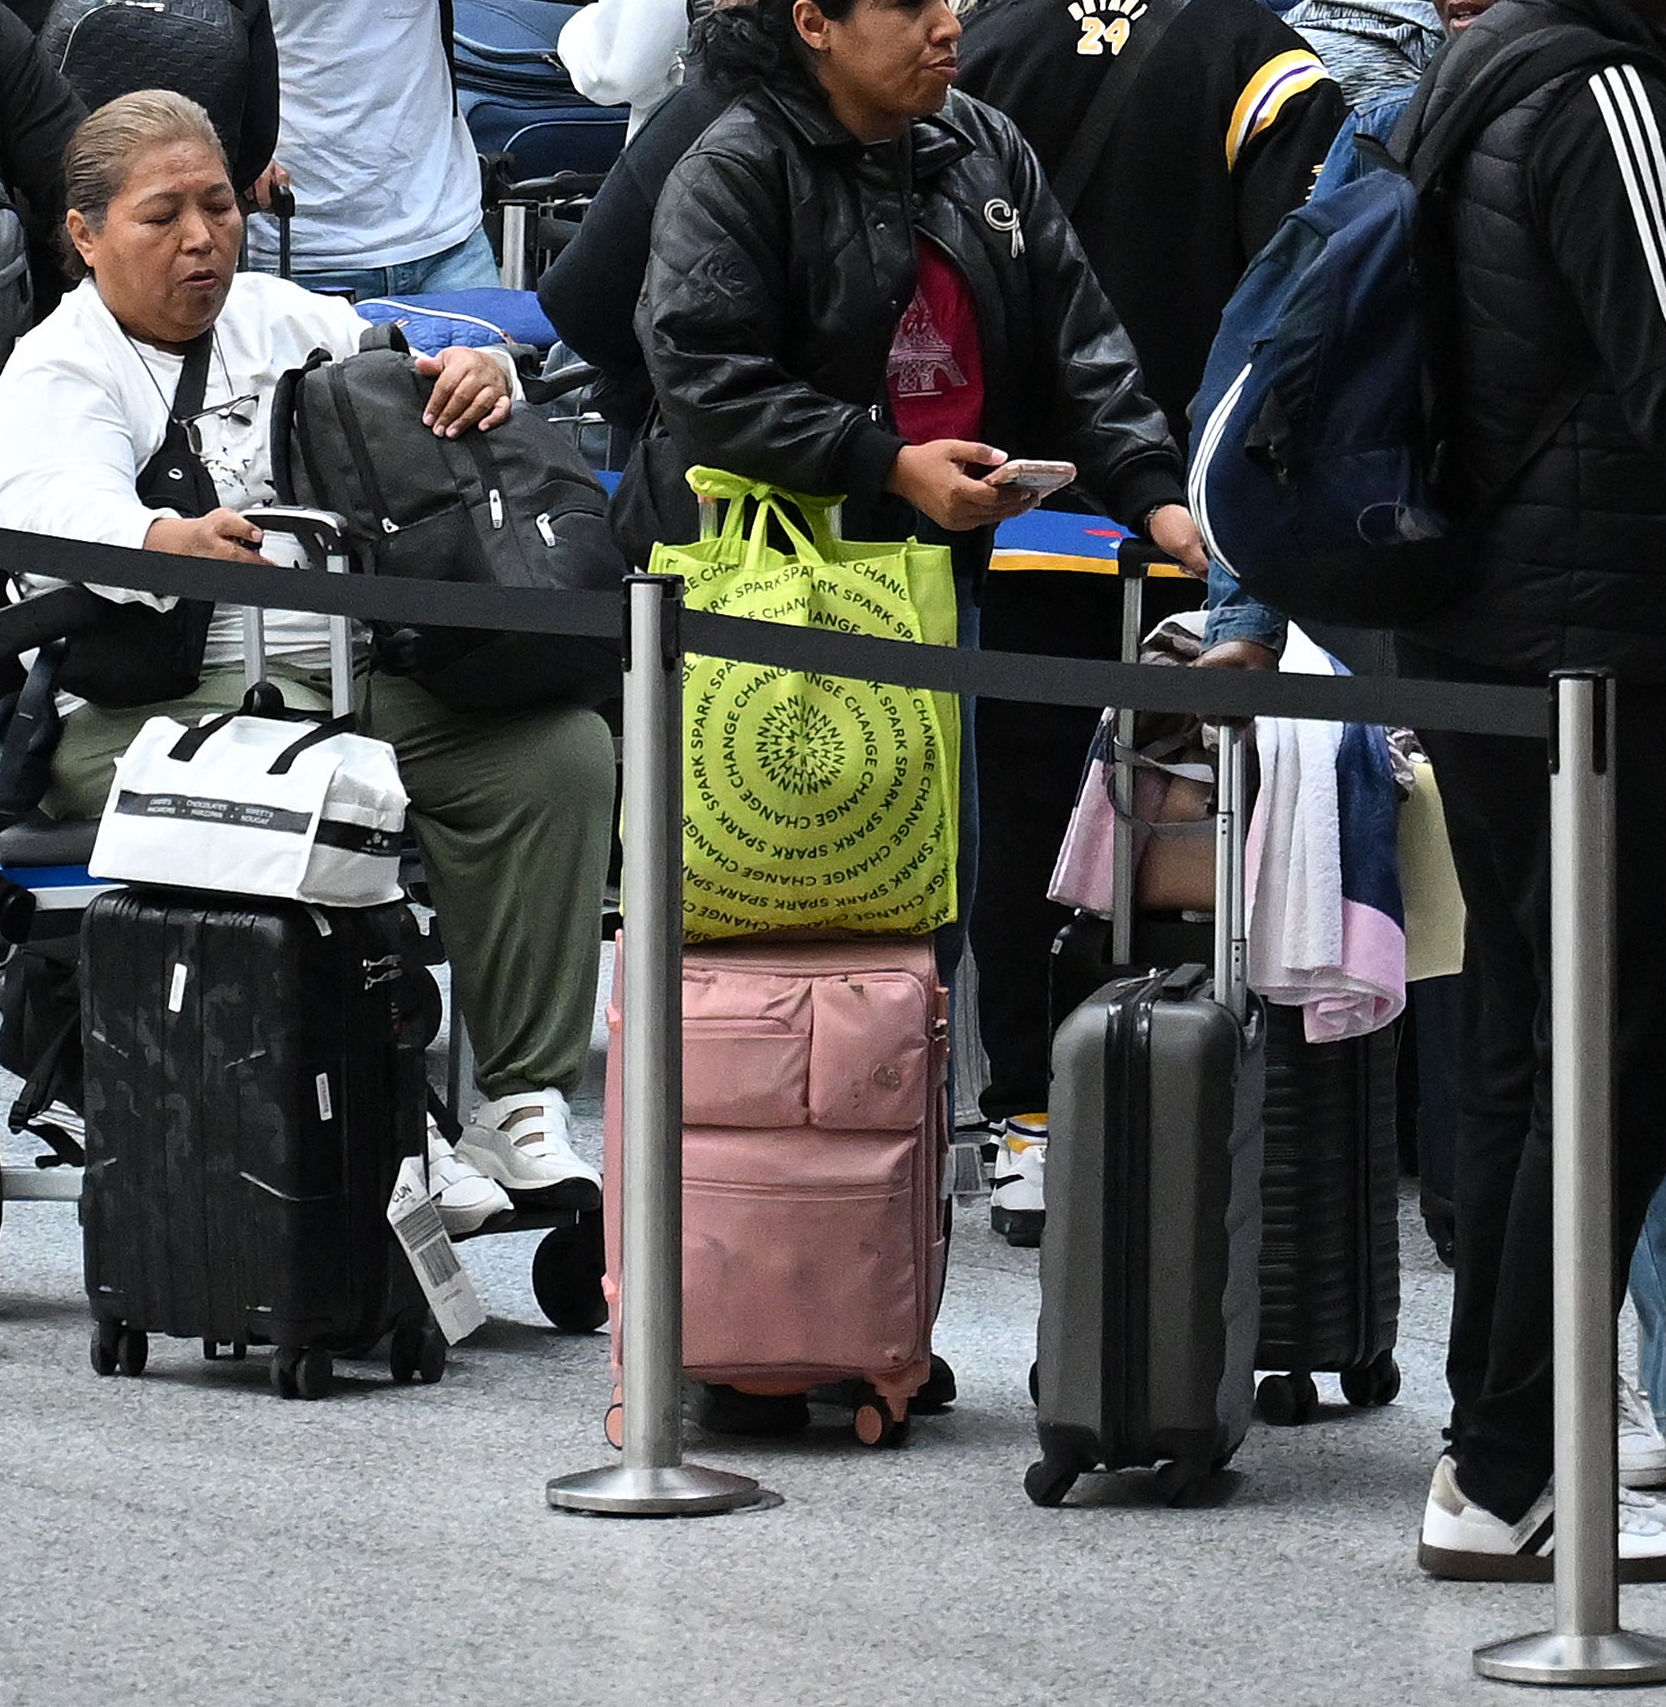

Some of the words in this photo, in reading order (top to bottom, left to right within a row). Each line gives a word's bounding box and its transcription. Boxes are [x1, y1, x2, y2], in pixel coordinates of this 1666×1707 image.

[1077, 16, 1130, 56] 24
[842, 588, 895, 625] SPARK
[691, 692, 716, 749] SPARK
[844, 695, 878, 767] CHANGE
[879, 696, 908, 751] SPARK
[913, 698, 936, 770] CHANGE
[722, 709, 745, 789] CHANGE
[691, 754, 720, 811] SPARK
[817, 770, 875, 827] CHANGE
[878, 754, 908, 812] SPARK
[739, 788, 811, 830] CHANGE
[889, 776, 932, 846] CHANGE
[716, 809, 766, 853] SPARK
[772, 843, 829, 860] SPARK
[832, 812, 883, 854] SPARK
[741, 865, 819, 887] CHANGE
[823, 844, 891, 886] CHANGE
[890, 843, 934, 888] SPARK
[715, 882, 769, 909] SPARK
[773, 896, 829, 912] SPARK
[834, 882, 890, 909] SPARK
[697, 904, 771, 933] CHANGE
